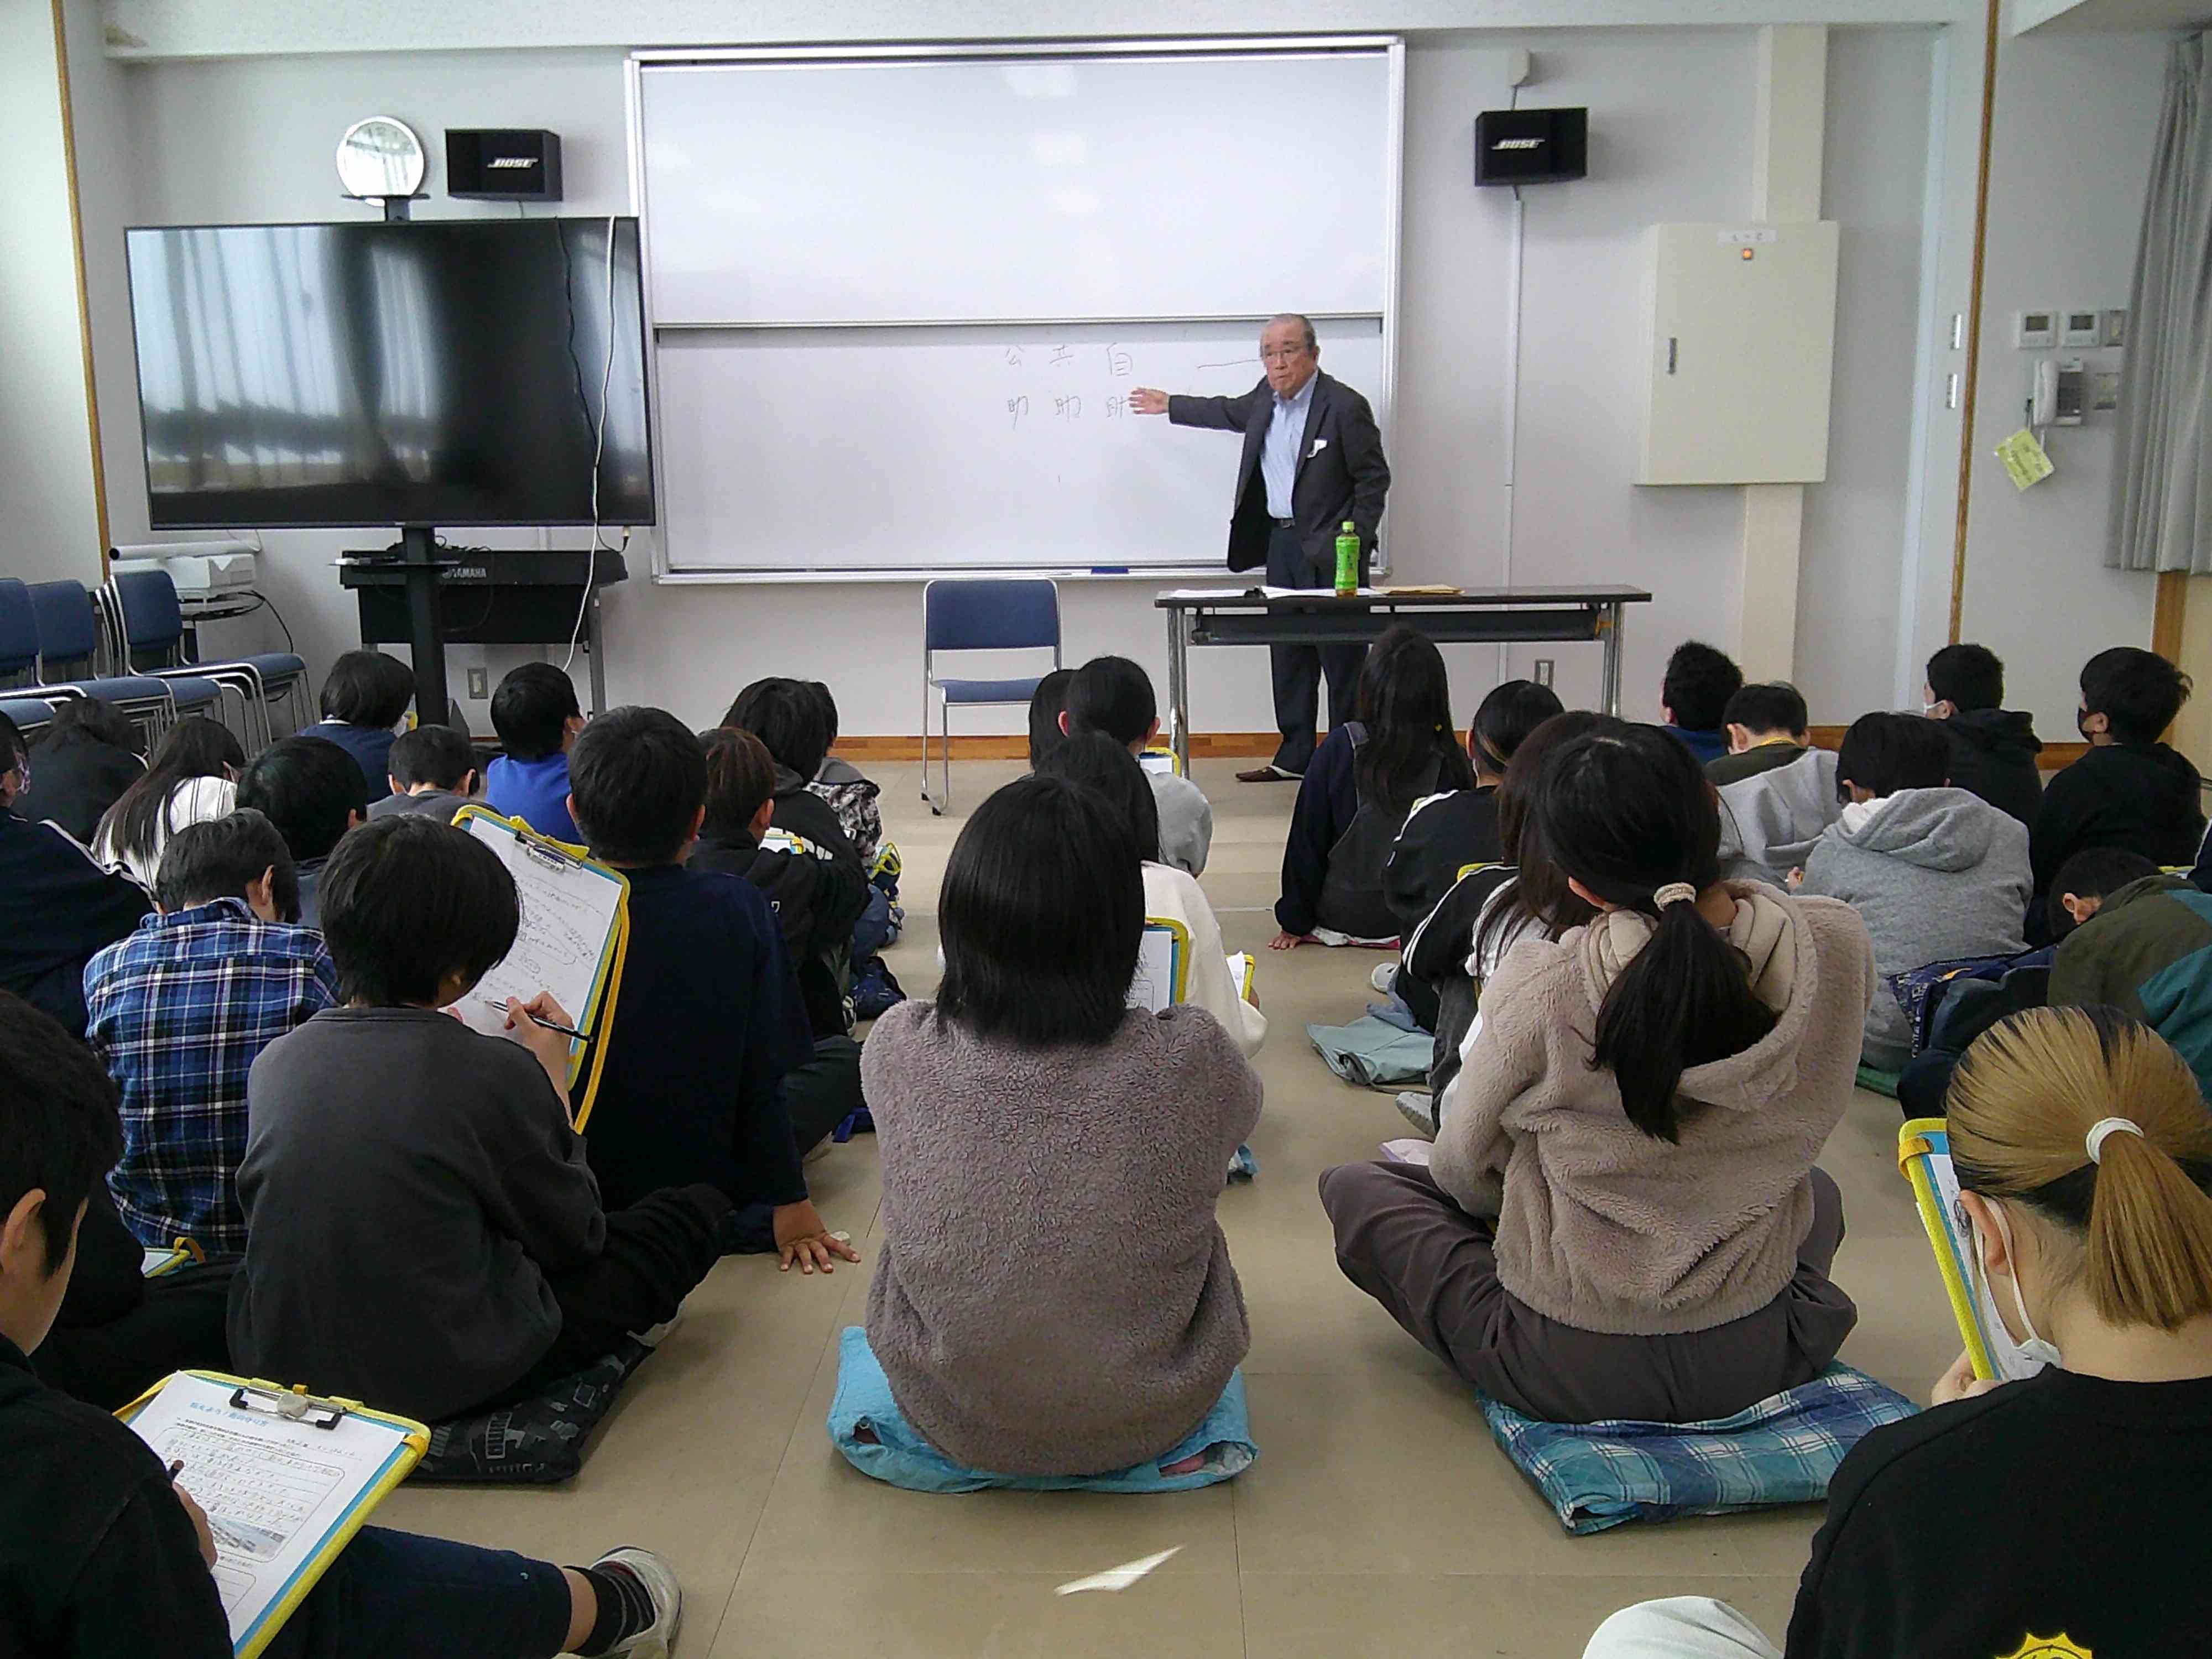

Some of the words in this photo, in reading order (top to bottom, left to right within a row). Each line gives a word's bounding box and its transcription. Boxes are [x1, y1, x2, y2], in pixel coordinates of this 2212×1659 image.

[1491, 138, 1545, 150] BOSE
[487, 156, 539, 168] BOSE
[452, 567, 487, 578] YAMAHA
